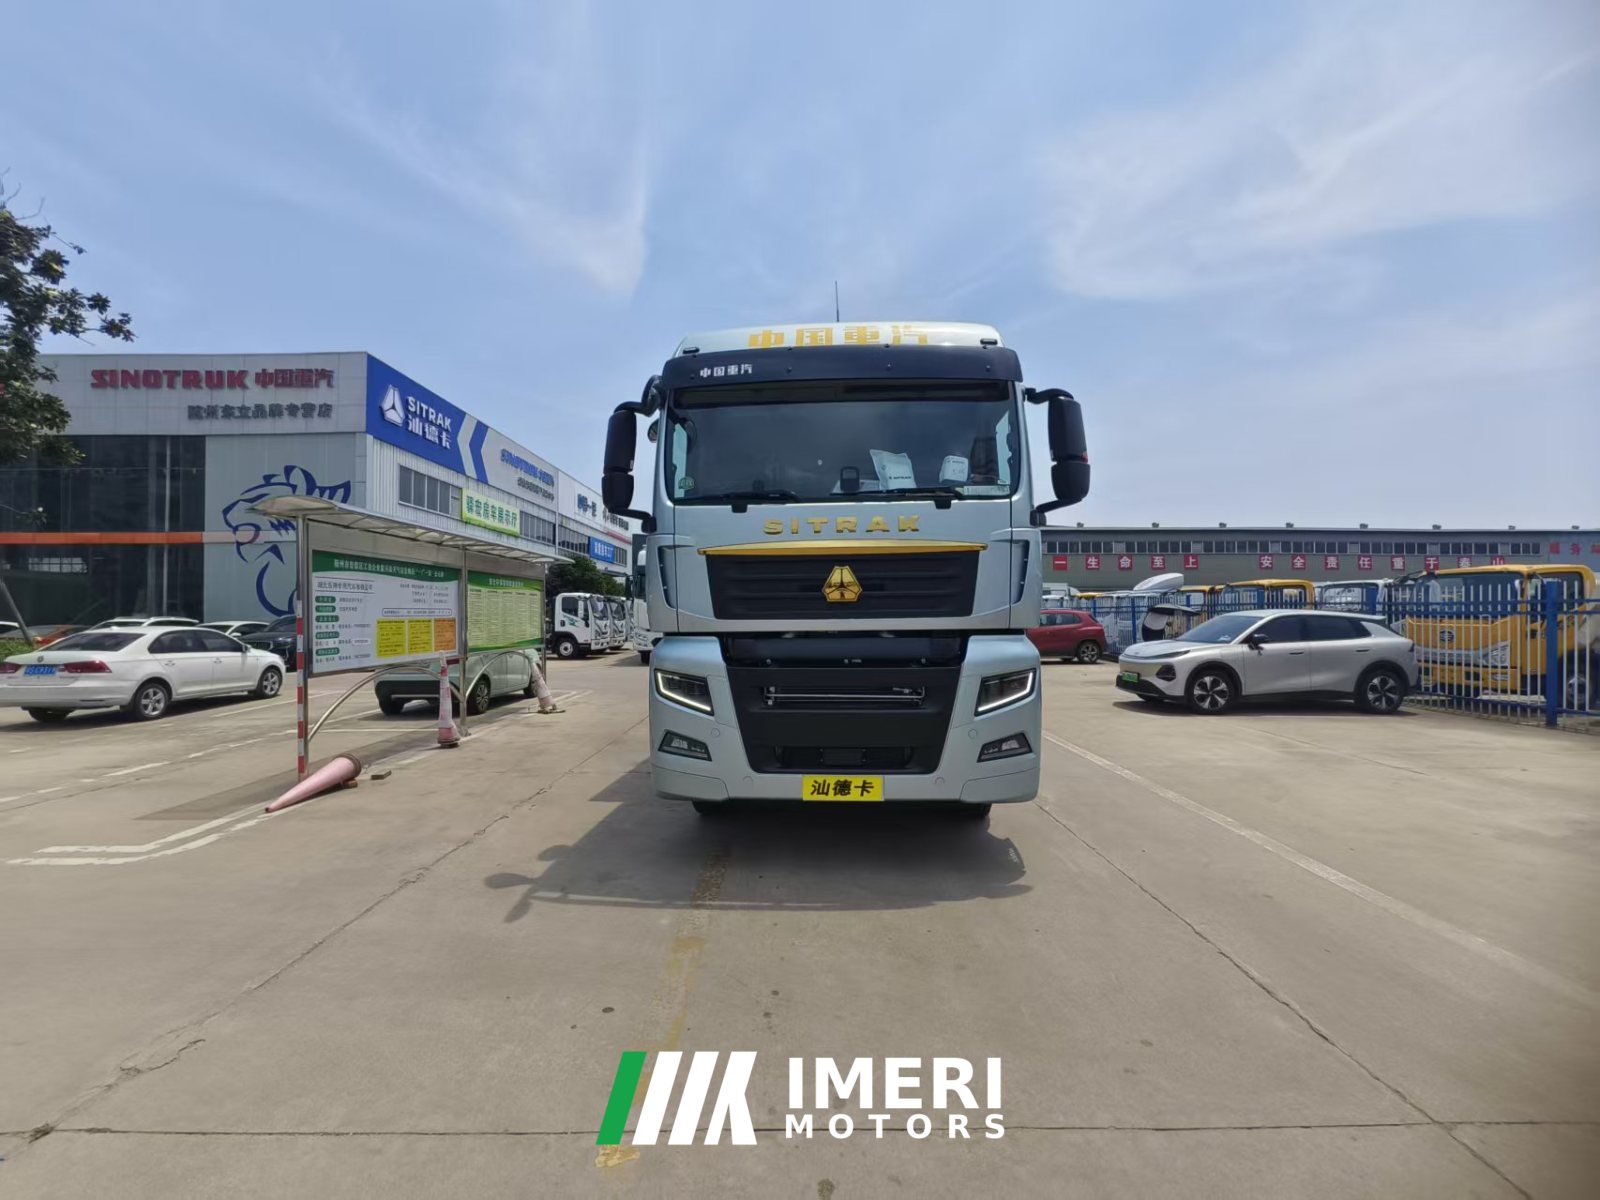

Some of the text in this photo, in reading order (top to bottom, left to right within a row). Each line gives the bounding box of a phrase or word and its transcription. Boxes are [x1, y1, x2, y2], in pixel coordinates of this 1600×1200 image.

[748, 325, 928, 348] 中国重汽
[91, 368, 334, 390] SINOTRUK 中国重汽
[700, 364, 753, 378] 中国重汽
[406, 395, 452, 432] SITRAK
[407, 413, 451, 449] 汕德卡
[762, 515, 920, 535] SITRAK
[1053, 555, 1505, 570] 一生命至上 安全责任重于泰山
[809, 779, 875, 797] 汕德卡
